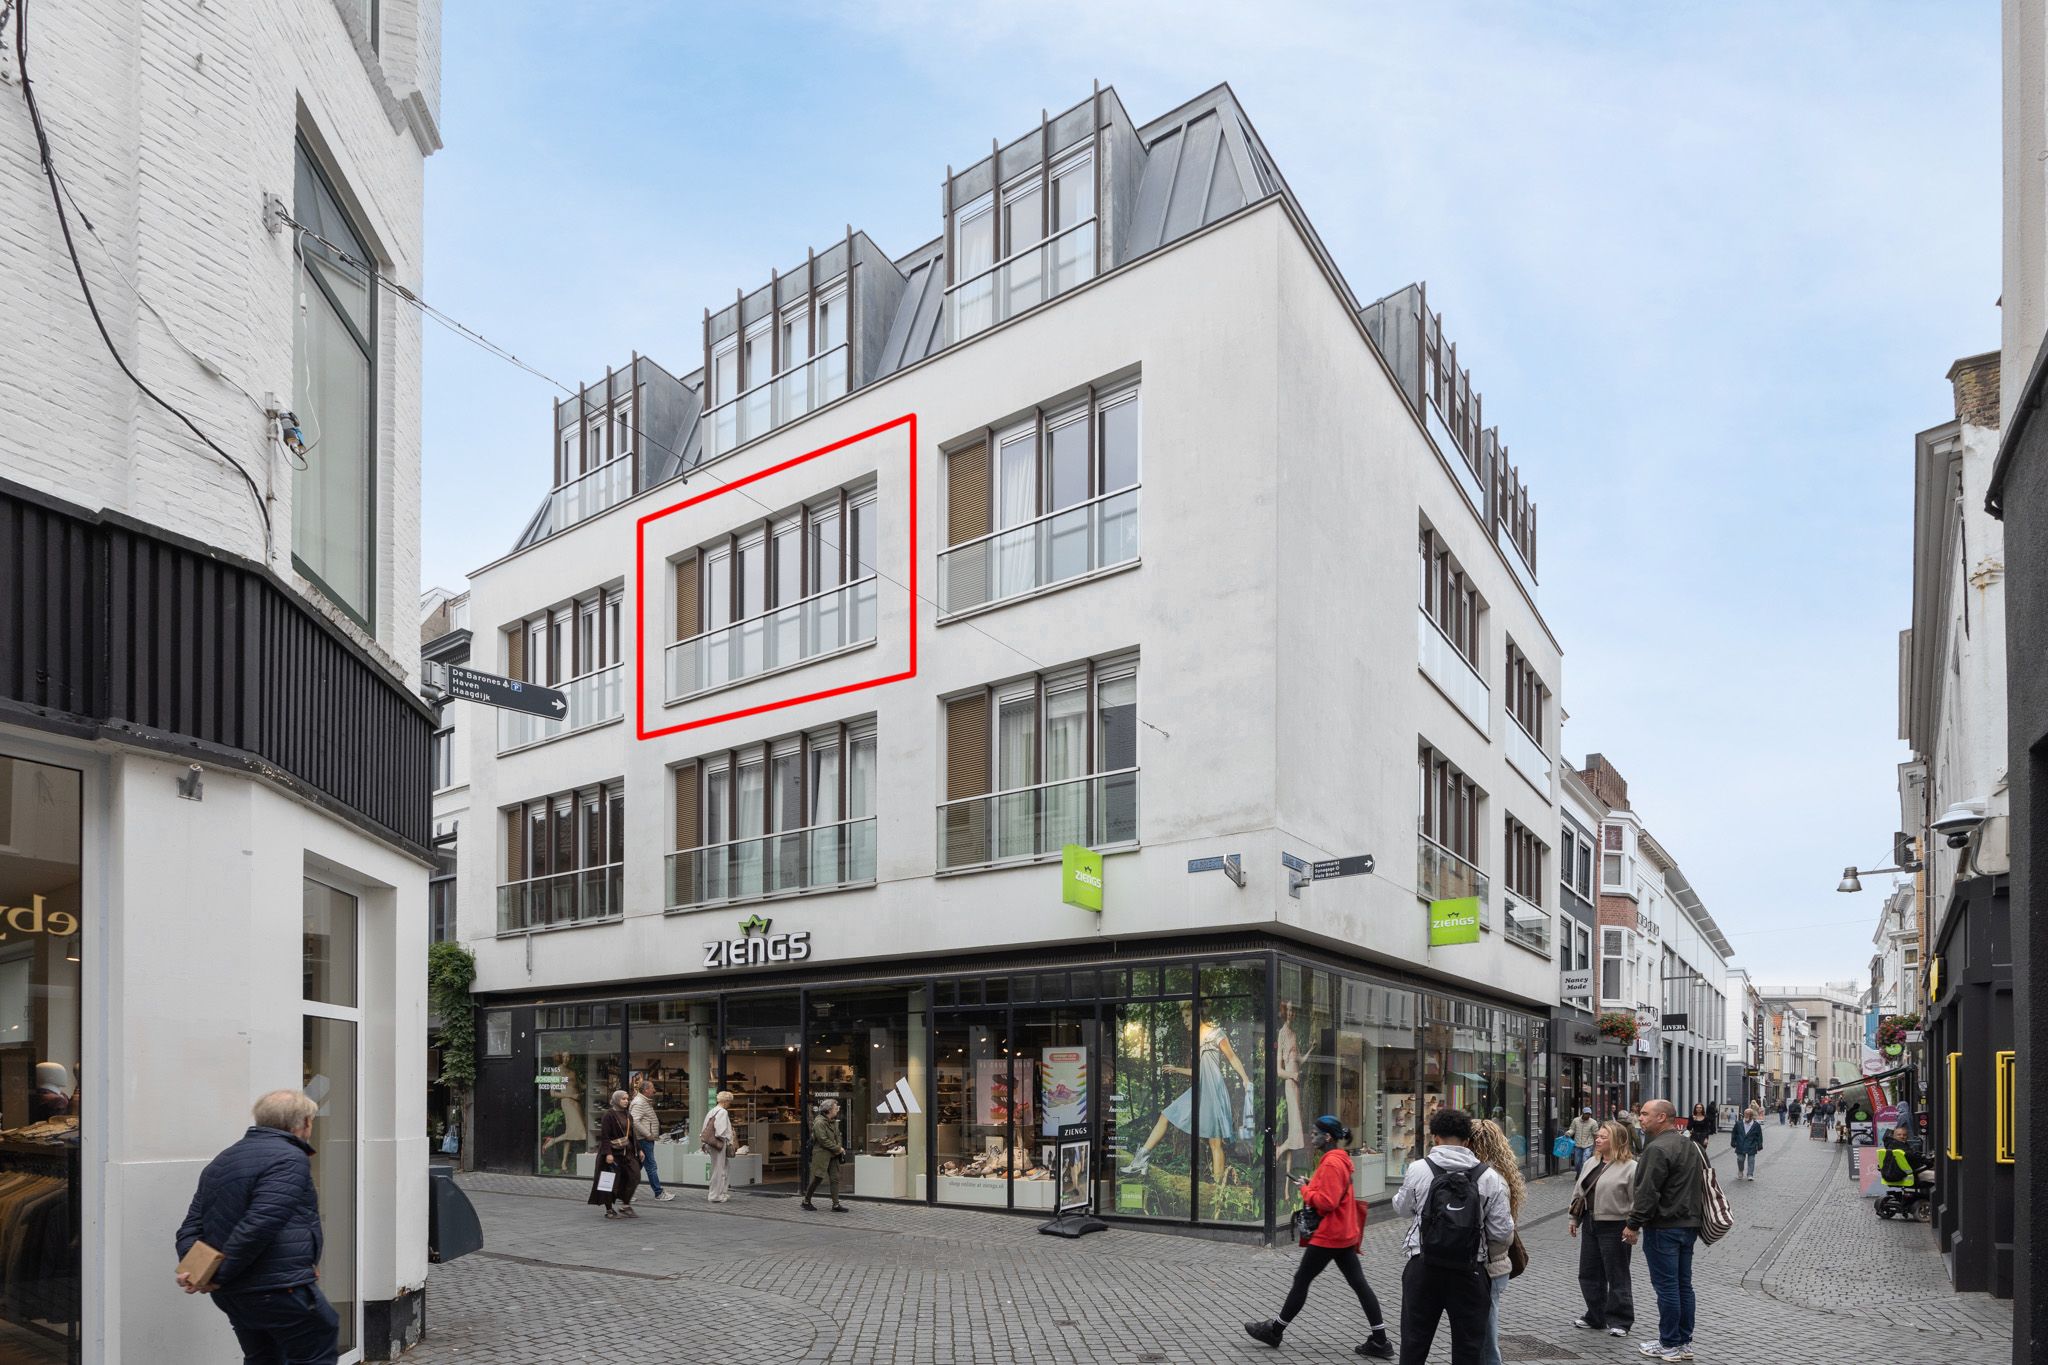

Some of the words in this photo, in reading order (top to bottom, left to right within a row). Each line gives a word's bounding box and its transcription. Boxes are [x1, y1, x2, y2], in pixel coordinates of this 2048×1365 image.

[452, 668, 464, 678] De
[466, 672, 501, 687] Barones
[452, 677, 480, 690] Haven
[452, 686, 491, 701] Haagdijk
[1075, 870, 1102, 889] ZIENGS
[1432, 916, 1475, 929] ZIENGS
[703, 931, 811, 968] ZIENGS
[1564, 977, 1589, 985] Nancy
[1566, 983, 1587, 991] Mode
[1064, 1127, 1088, 1136] ZIENGS
